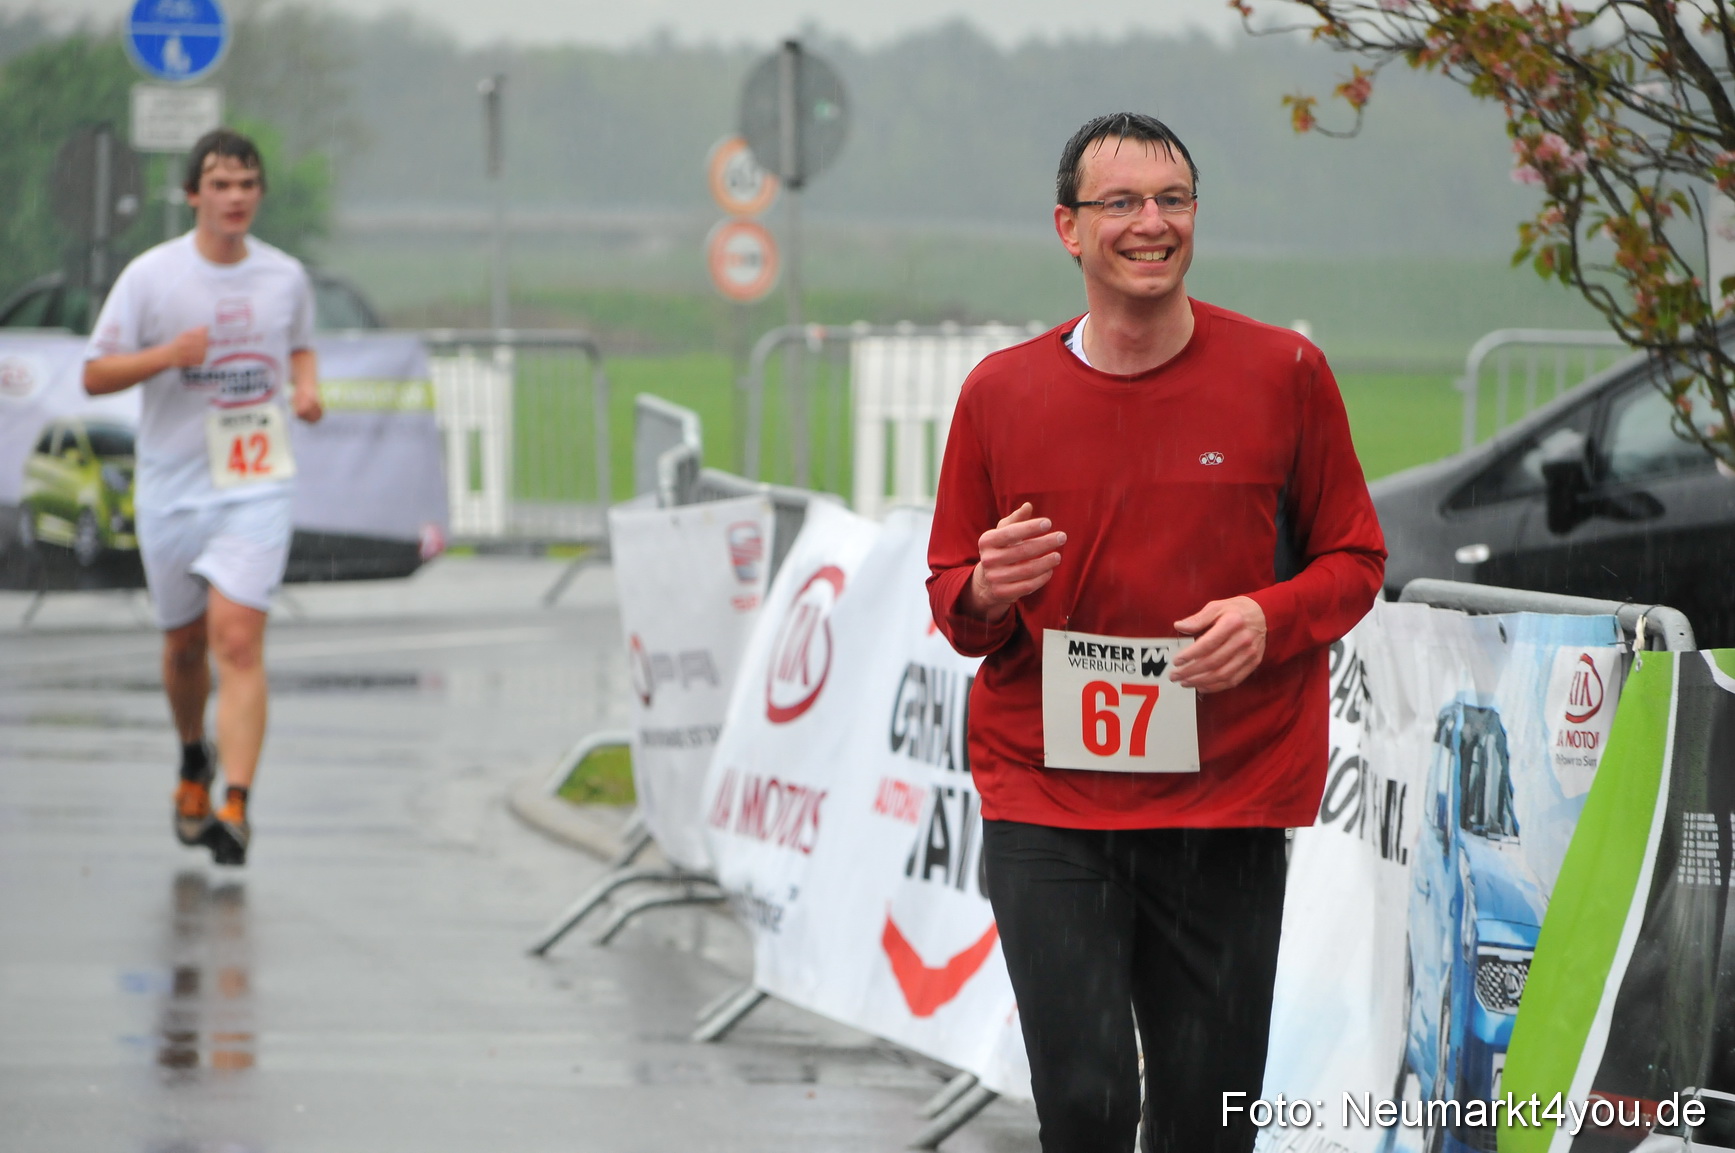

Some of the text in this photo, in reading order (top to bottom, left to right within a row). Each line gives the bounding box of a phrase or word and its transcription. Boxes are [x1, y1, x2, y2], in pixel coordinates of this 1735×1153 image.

[227, 430, 273, 476] 42
[1068, 640, 1135, 661] MEYER
[1068, 656, 1137, 675] WERBUNG
[1081, 680, 1160, 757] 67
